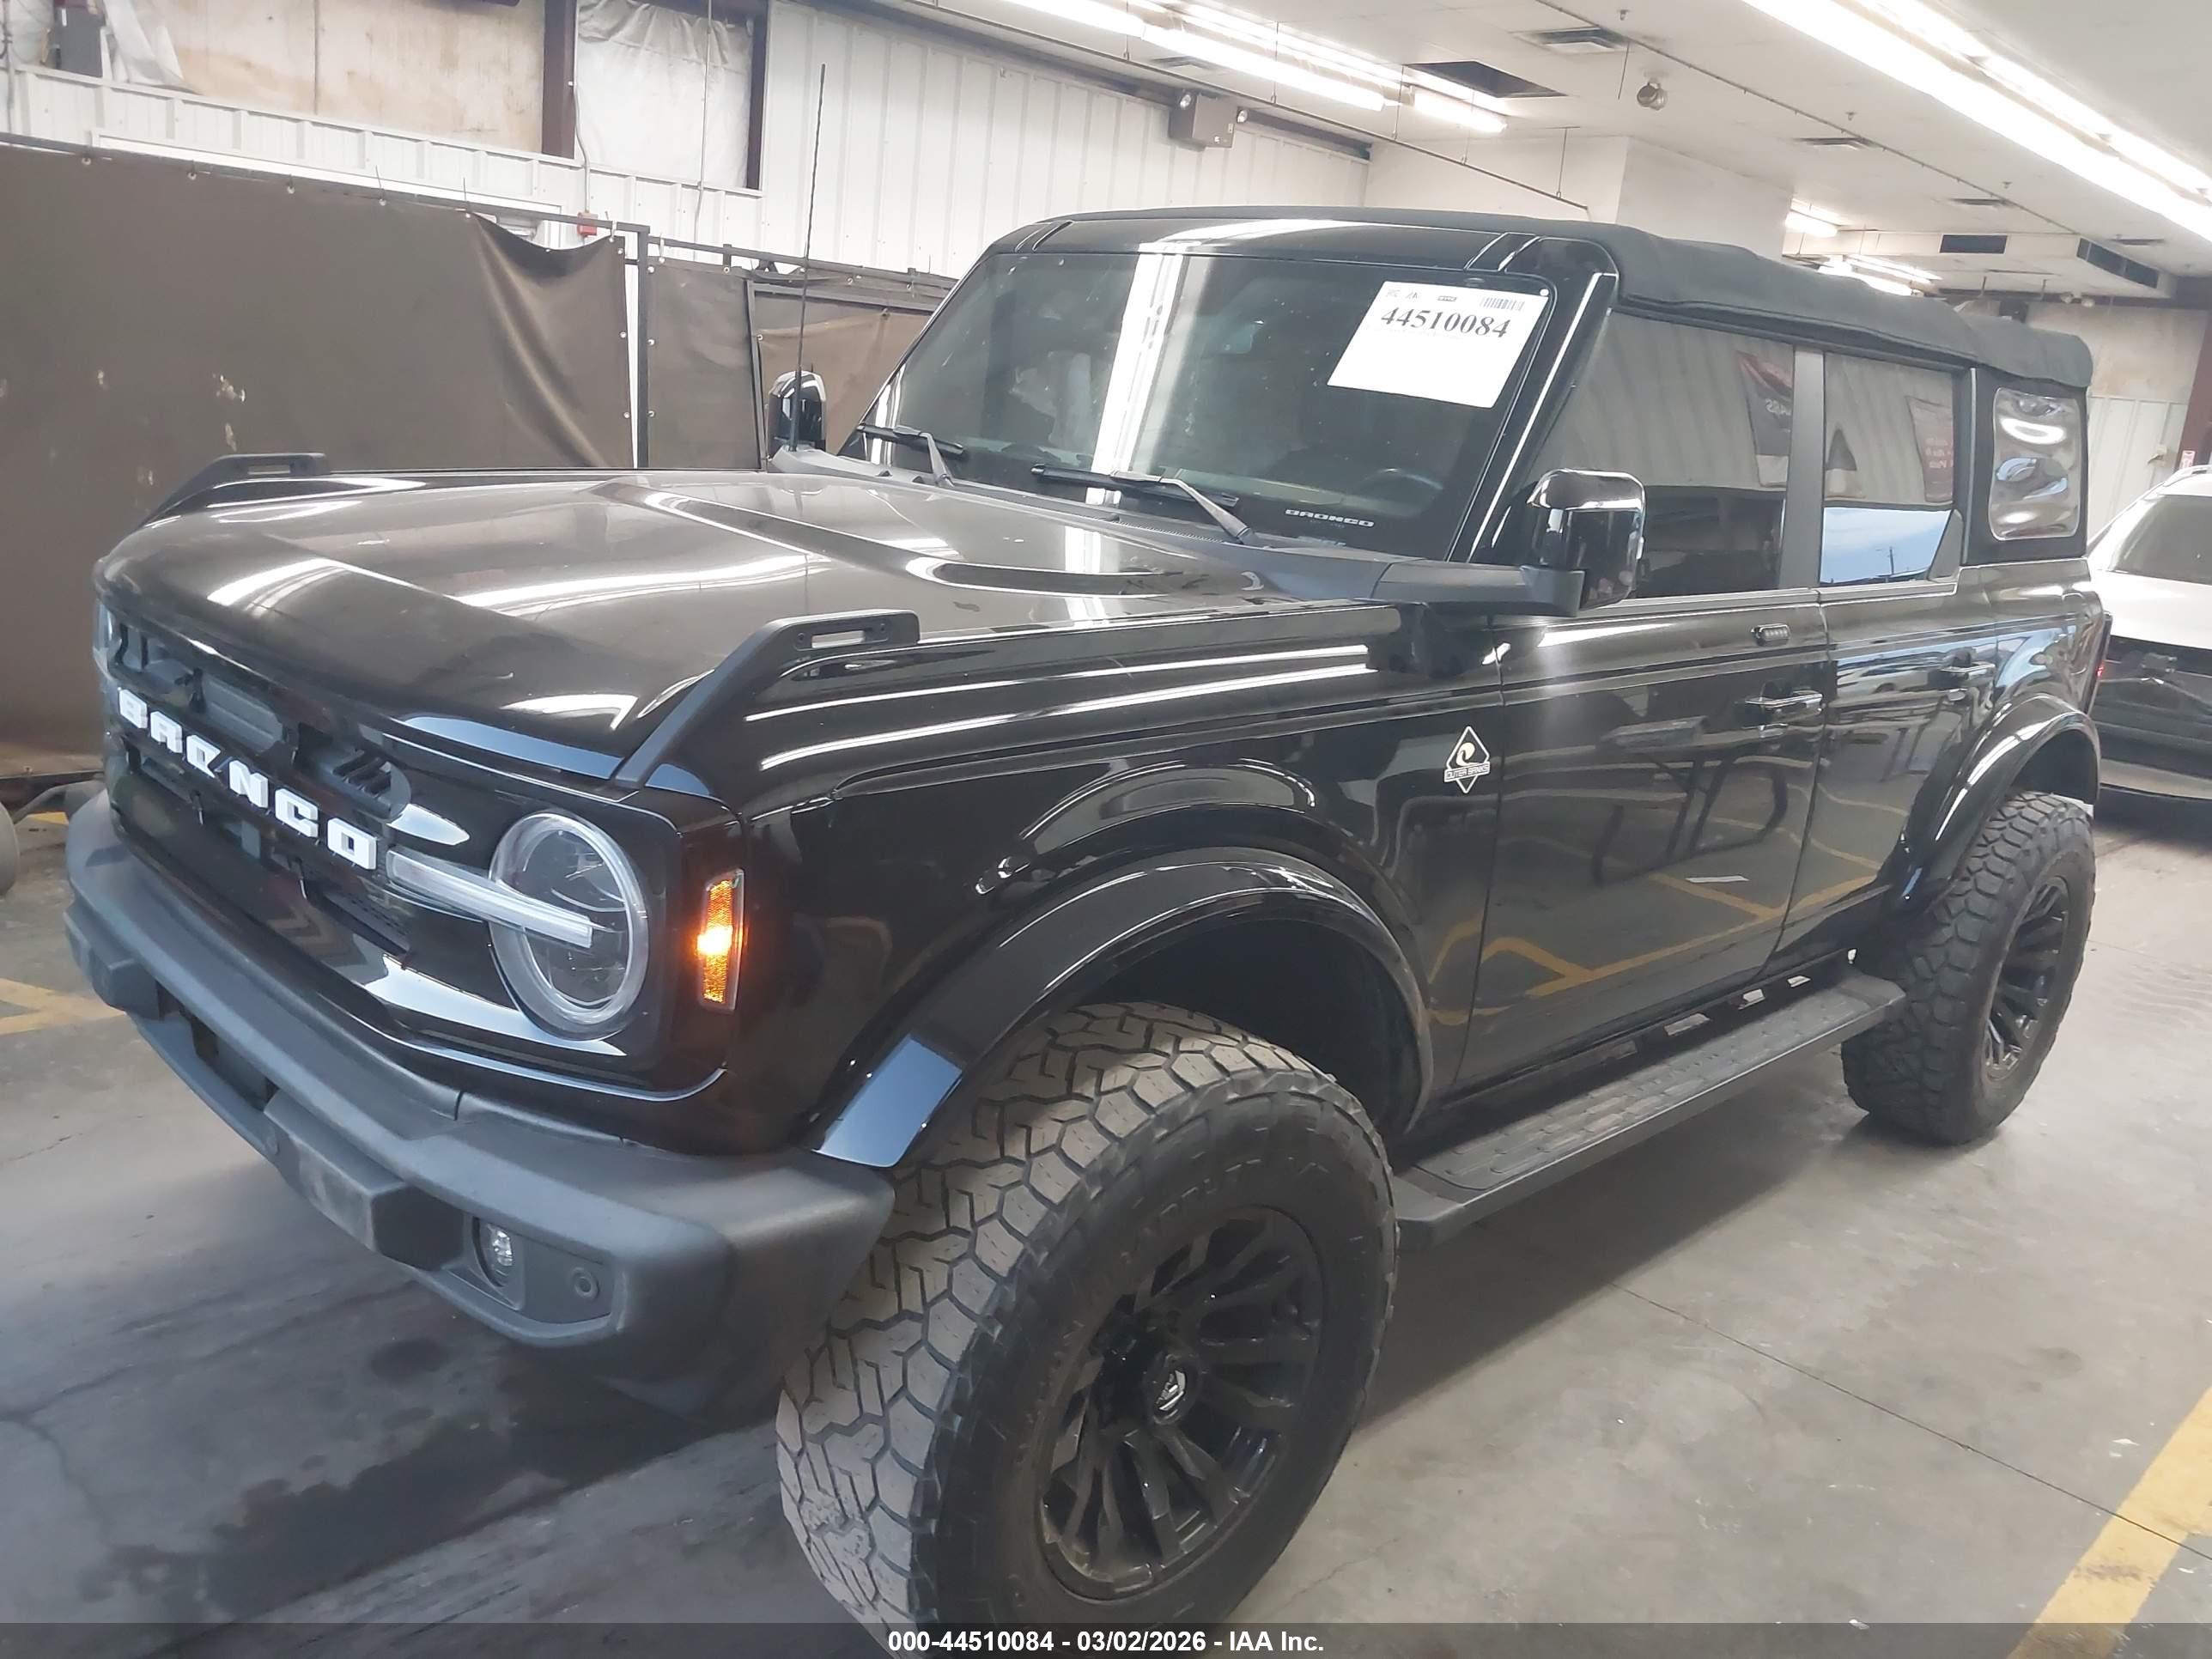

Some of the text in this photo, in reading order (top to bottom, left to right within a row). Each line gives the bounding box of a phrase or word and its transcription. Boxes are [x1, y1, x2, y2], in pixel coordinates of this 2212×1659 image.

[1381, 307, 1511, 338] 44510084
[1285, 508, 1375, 527] BRONCO
[118, 688, 378, 871] BRONCO
